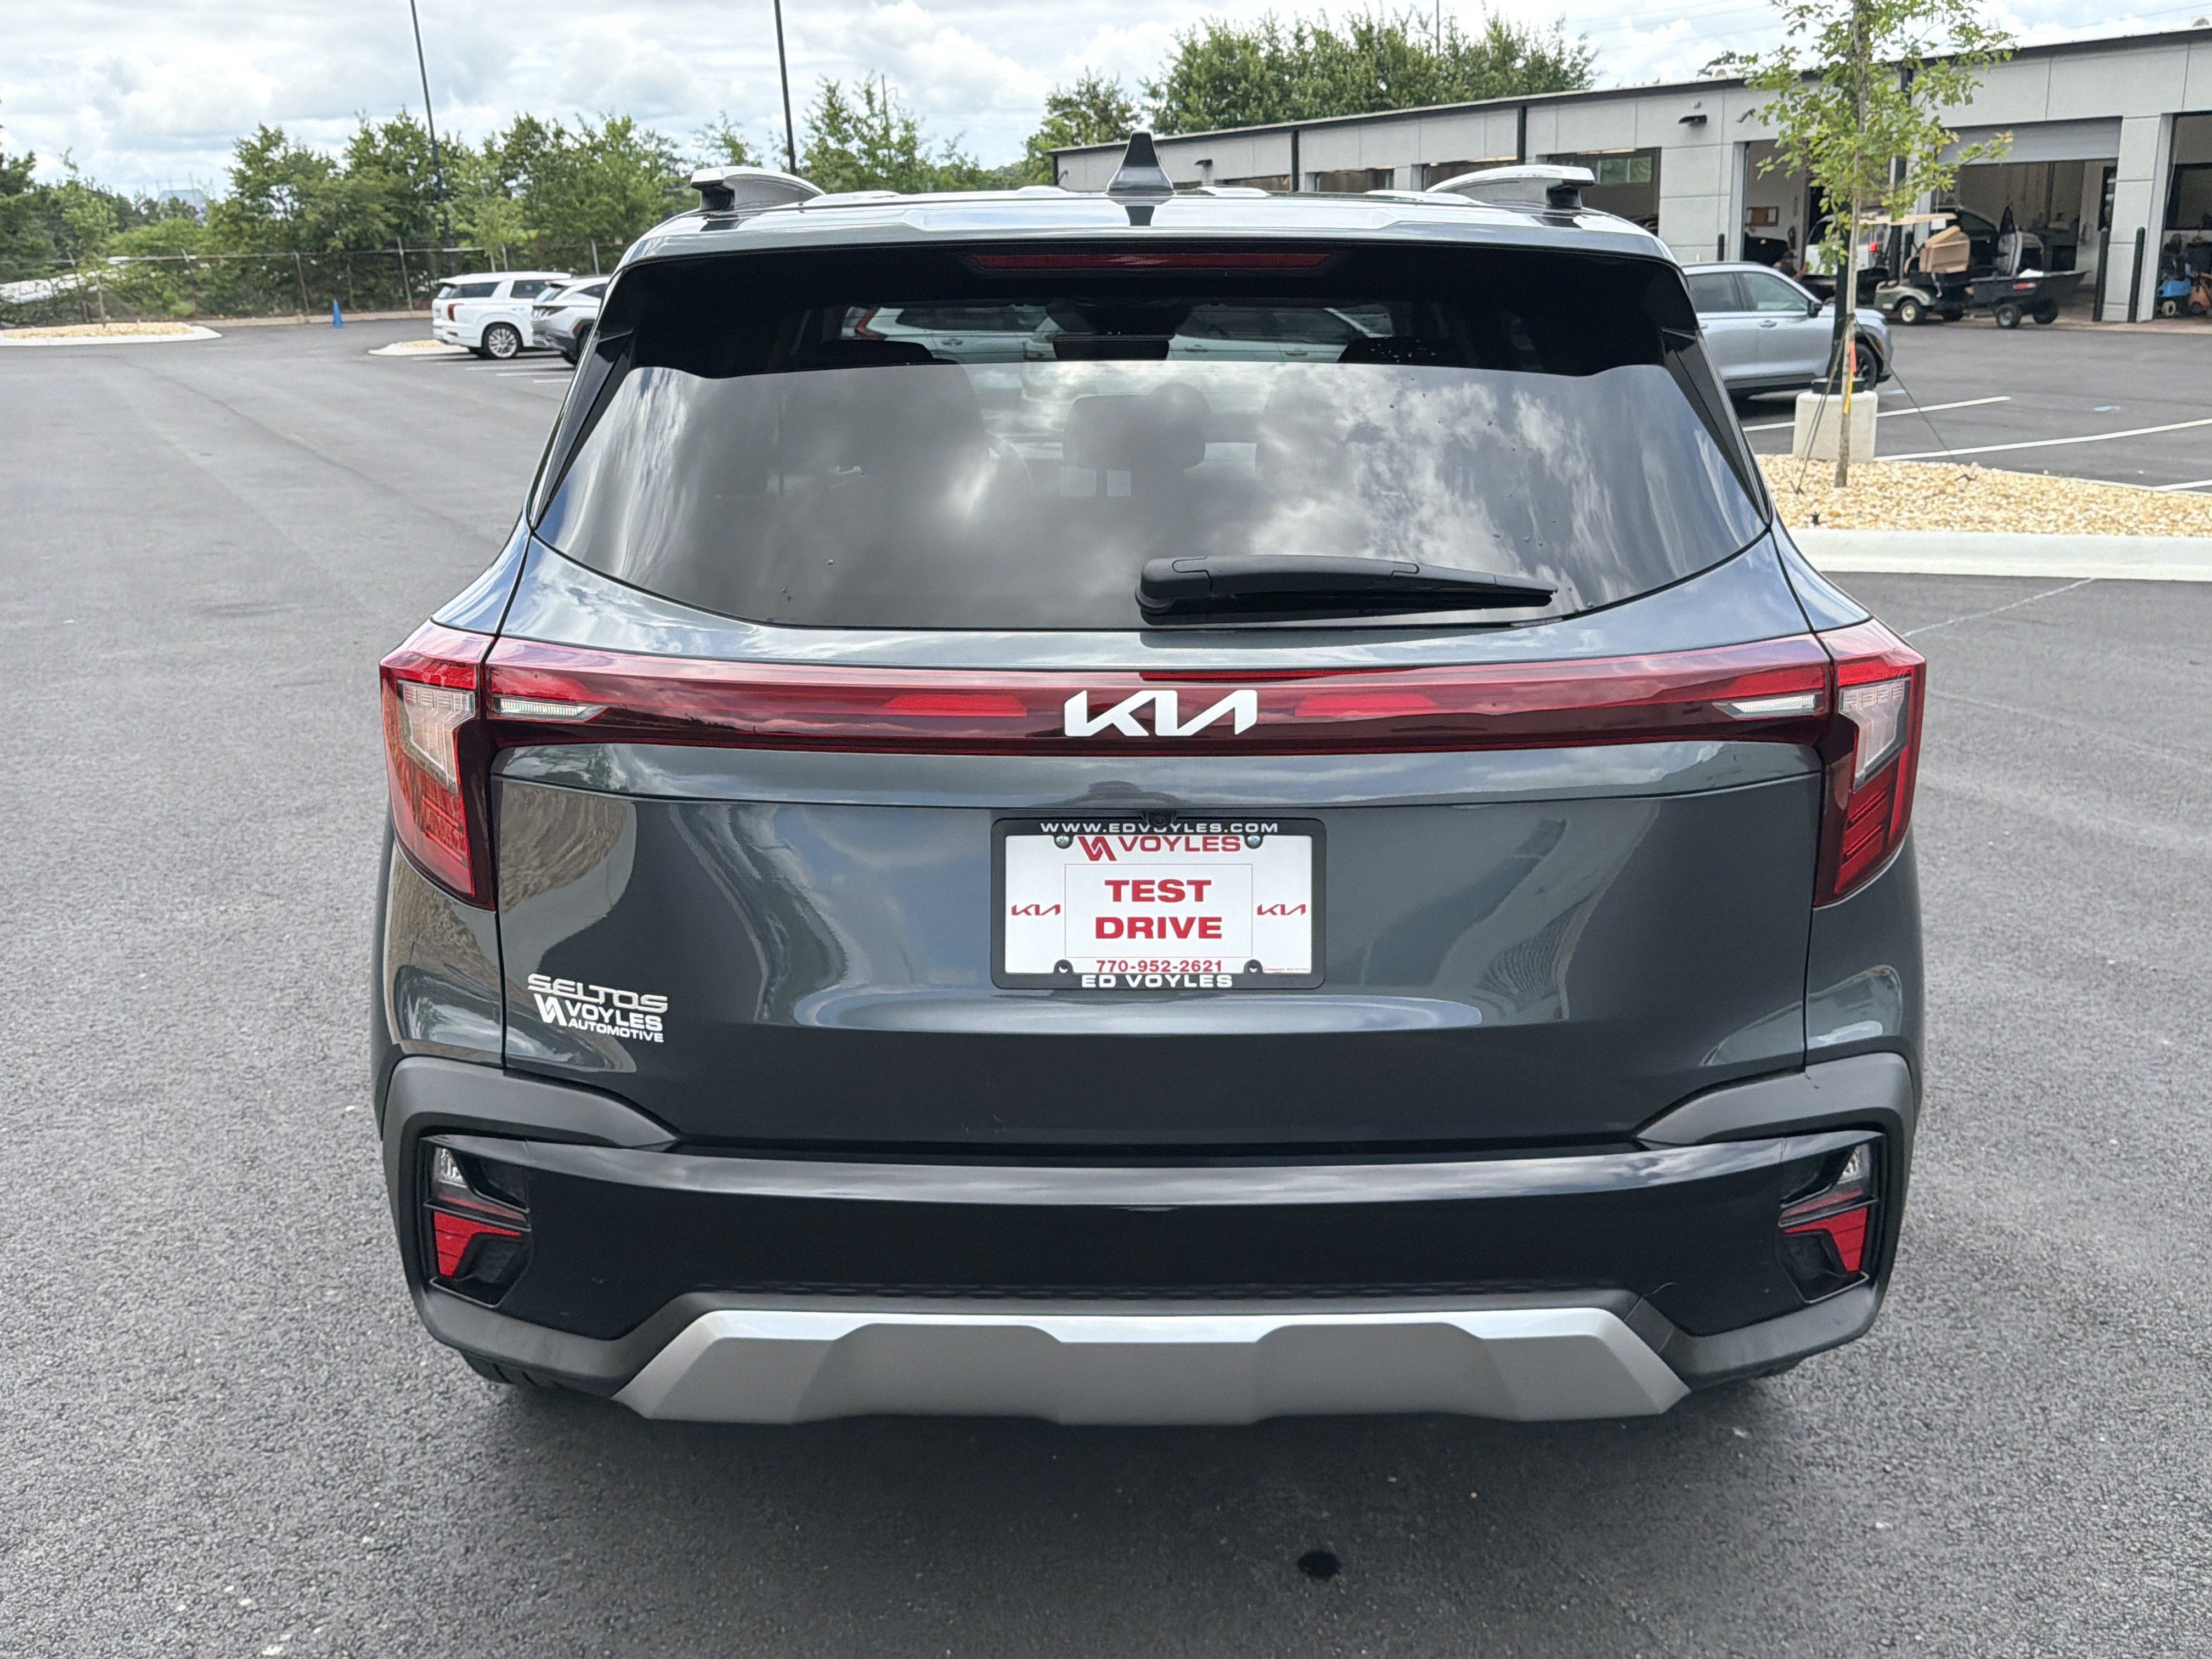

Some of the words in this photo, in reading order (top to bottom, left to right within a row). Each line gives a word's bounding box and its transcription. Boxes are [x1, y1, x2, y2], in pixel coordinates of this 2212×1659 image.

[1064, 690, 1257, 736] KIA
[1118, 836, 1240, 851] VOYLES
[1104, 879, 1212, 902] TEST
[1011, 904, 1060, 916] KIA
[1257, 904, 1306, 916] KIA
[1096, 917, 1222, 939] DRIVE
[1096, 960, 1222, 972] 770-952-2621
[1081, 974, 1116, 988] ED
[1125, 974, 1233, 988] VOYLES
[527, 973, 668, 1013] SELTOS
[565, 999, 663, 1031] VOYLES
[568, 1018, 664, 1043] AUTOMOTIVE
